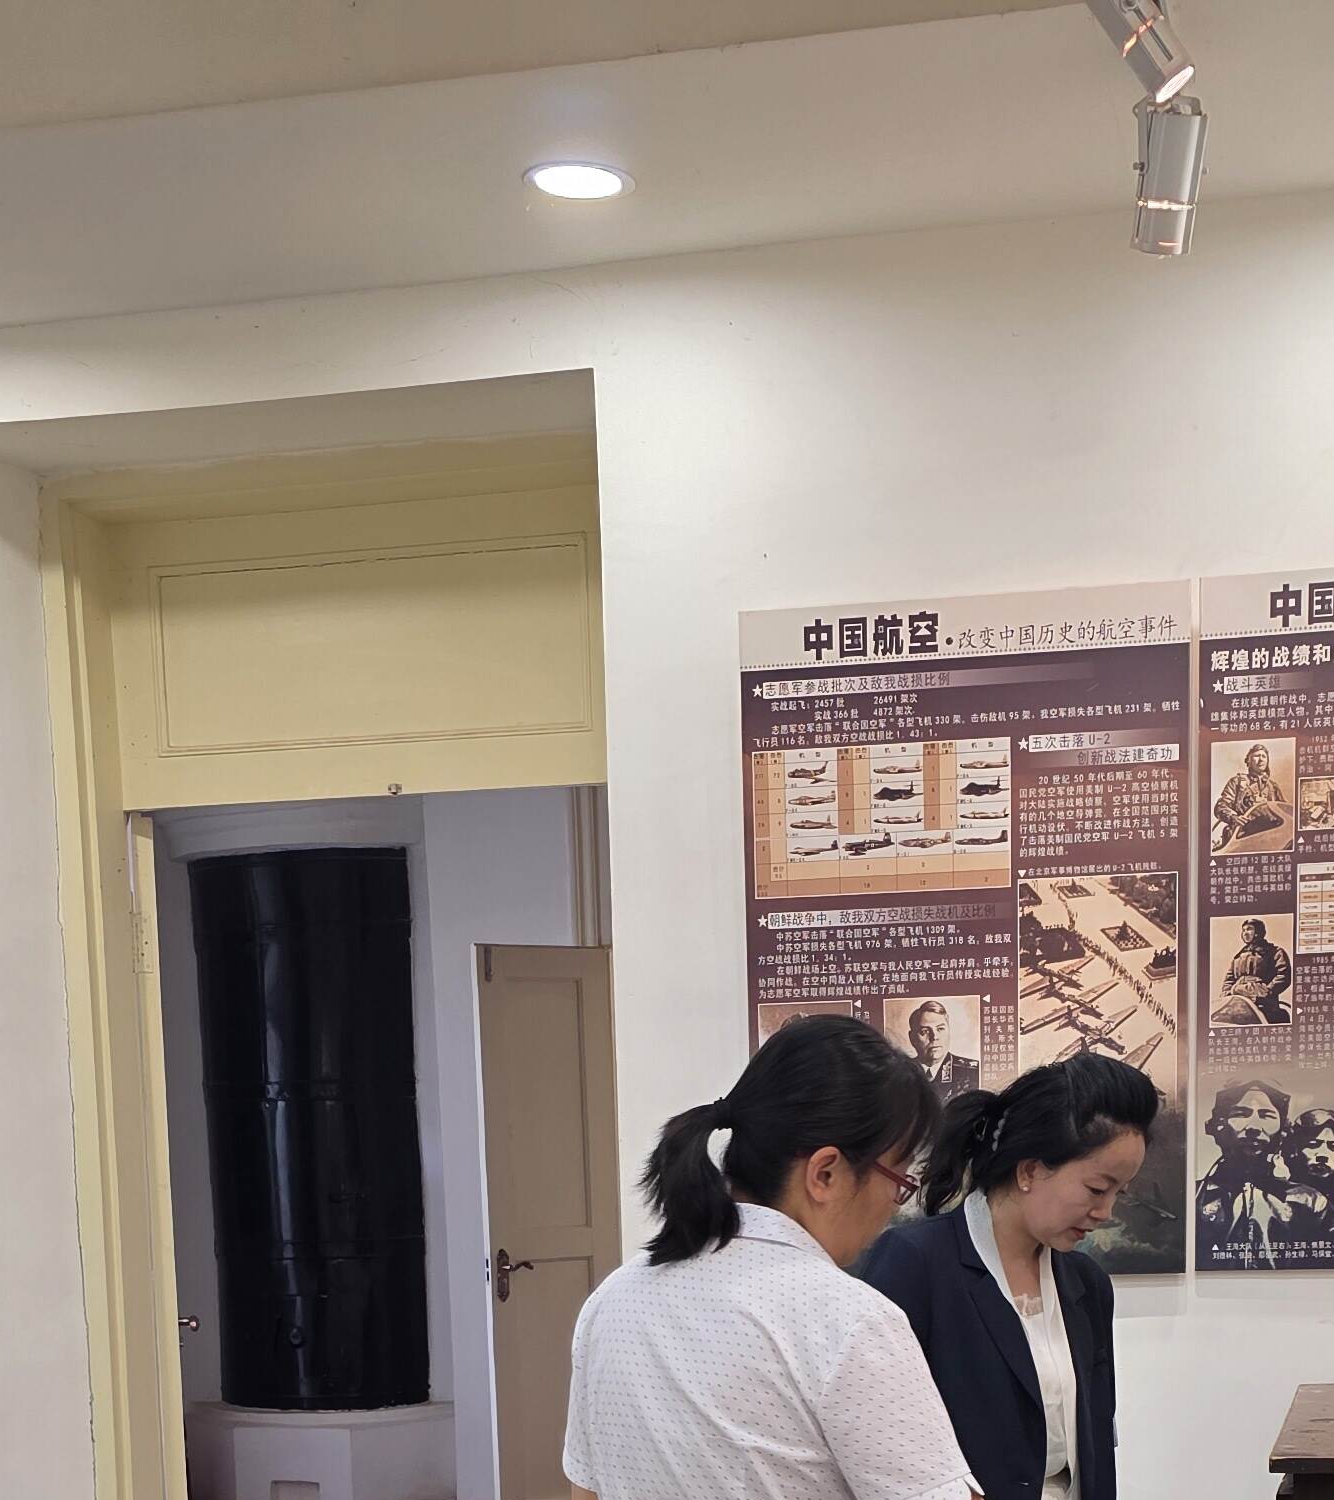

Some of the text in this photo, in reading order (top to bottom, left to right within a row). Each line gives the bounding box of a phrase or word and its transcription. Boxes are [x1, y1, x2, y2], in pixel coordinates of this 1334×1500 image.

[765, 672, 951, 697] 志愿军参战批次及敌我战损比例
[1226, 675, 1280, 692] 战斗英雄
[1077, 747, 1173, 765] 创新战法建奇功
